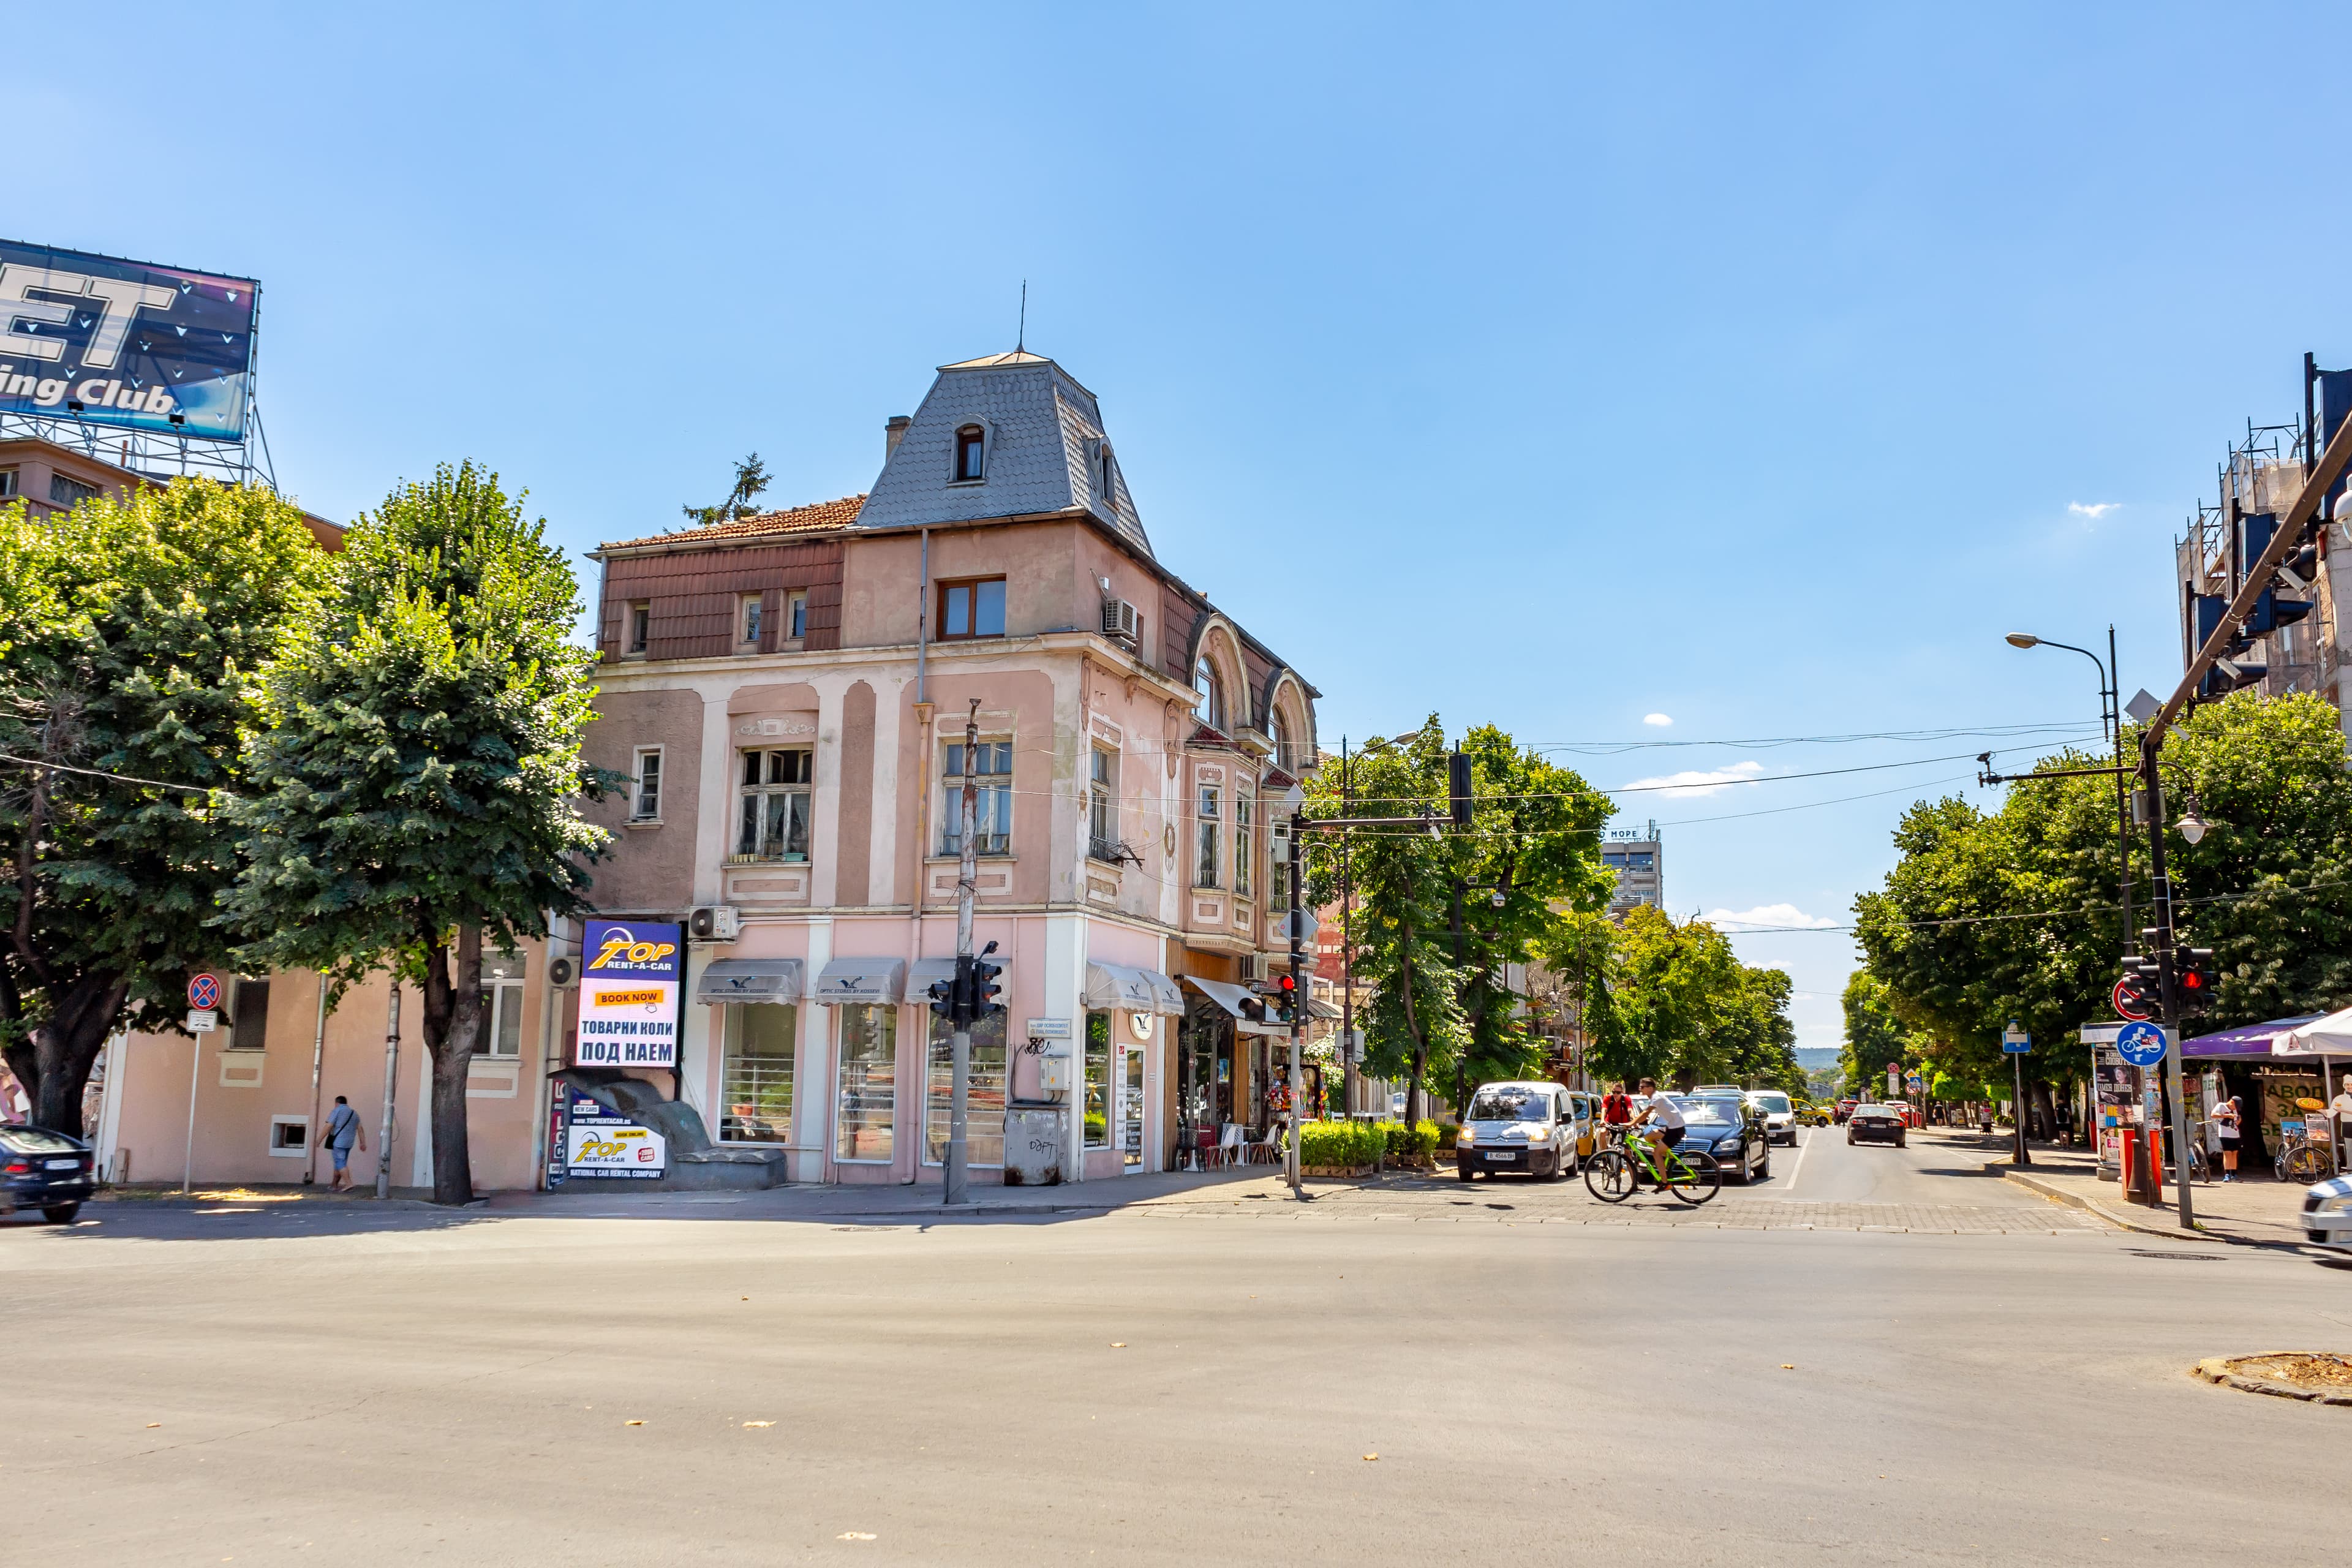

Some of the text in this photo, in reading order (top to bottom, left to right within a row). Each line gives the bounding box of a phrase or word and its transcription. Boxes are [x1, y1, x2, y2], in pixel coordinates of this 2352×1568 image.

[76, 378, 175, 415] Club
[588, 941, 675, 970] TOP
[607, 961, 672, 971] RENT-A-CAR
[601, 992, 658, 1003] BOOK NOW
[582, 1020, 673, 1036] ТОВАРНИ КОЛИ
[582, 1042, 673, 1063] ПОД НАЕМ
[573, 1141, 627, 1163] TOP
